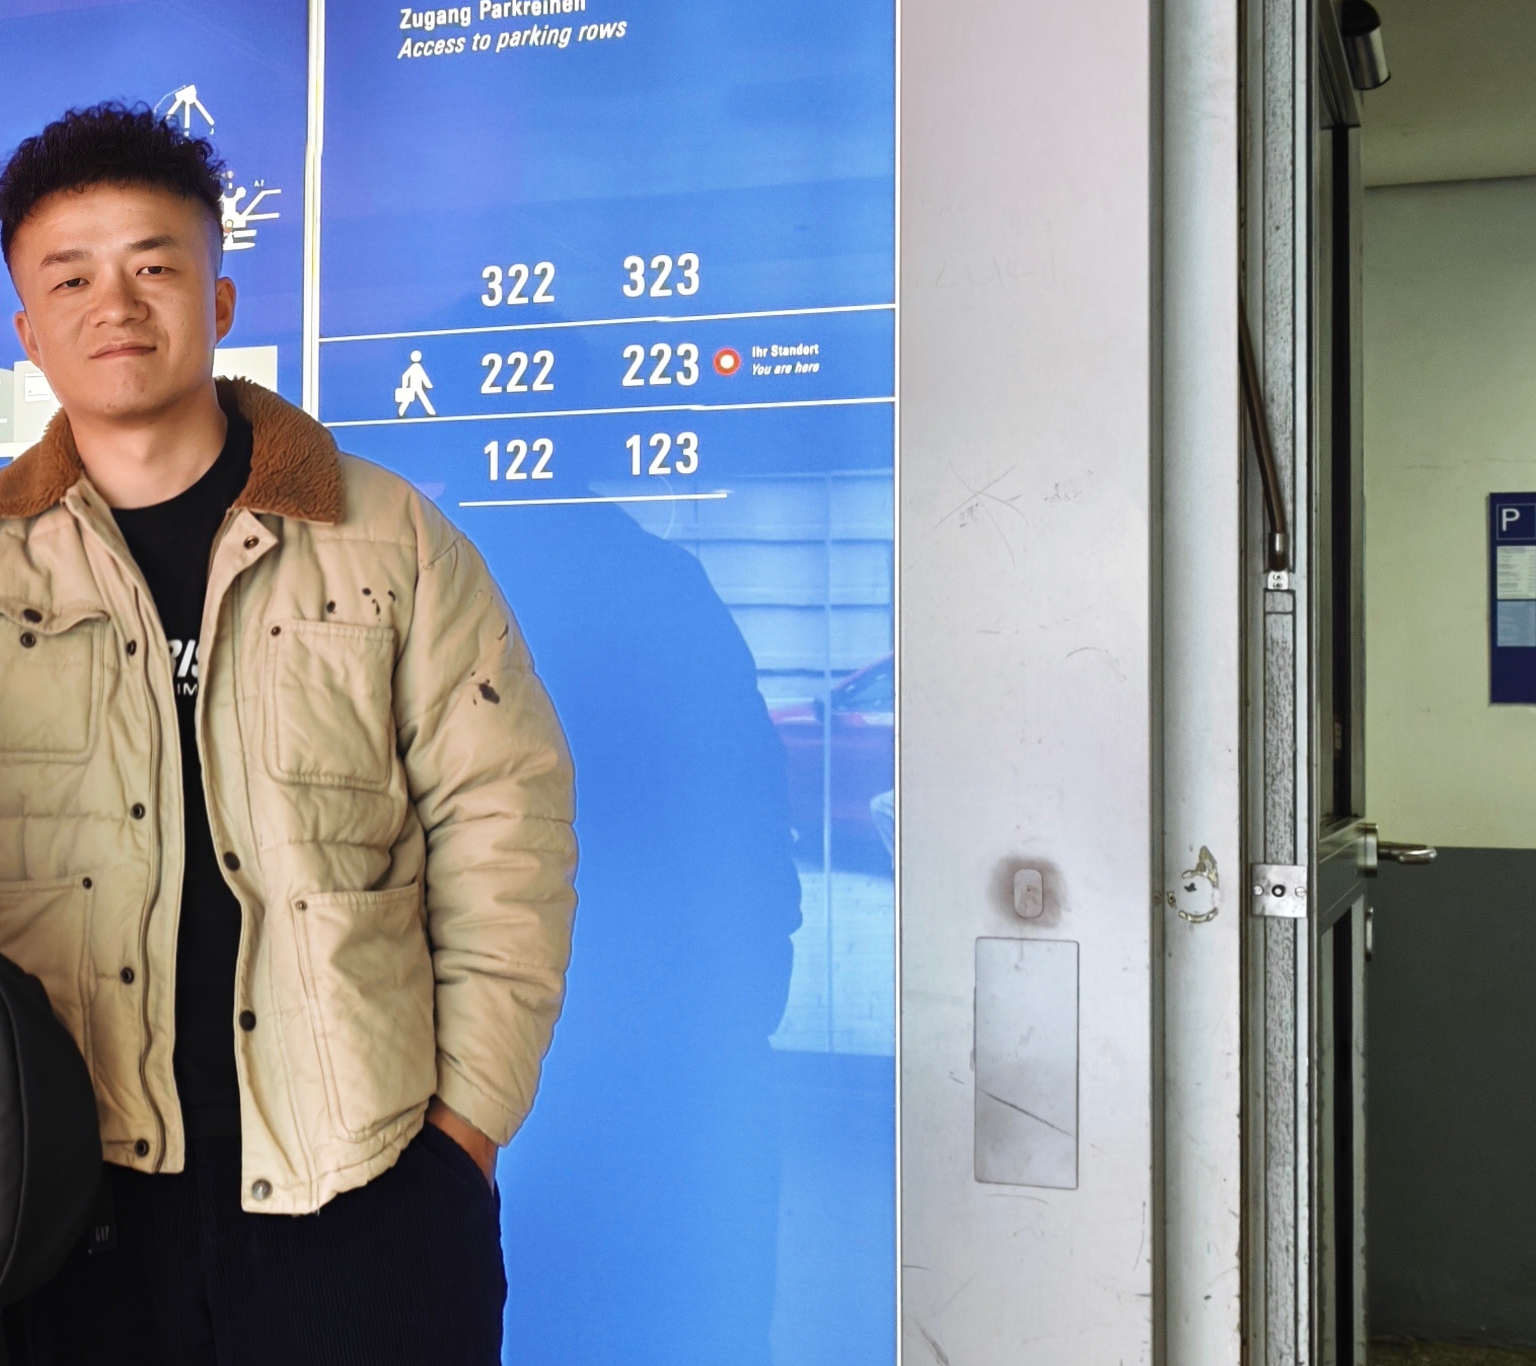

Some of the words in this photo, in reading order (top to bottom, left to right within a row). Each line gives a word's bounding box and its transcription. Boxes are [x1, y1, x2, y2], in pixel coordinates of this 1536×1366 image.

[399, 8, 471, 31] Zugang
[397, 37, 466, 60] Access
[472, 33, 491, 52] to
[495, 24, 572, 53] parking
[578, 21, 627, 42] rows
[481, 261, 556, 307] 322
[622, 252, 700, 298] 323
[751, 345, 768, 359] Ihr
[770, 343, 820, 358] Standort
[480, 349, 555, 394] 222
[621, 342, 700, 387] 223
[751, 363, 772, 376] You
[773, 364, 793, 375] are
[794, 361, 820, 374] here
[484, 438, 554, 481] 122
[625, 431, 699, 476] 123
[1501, 507, 1521, 532] P
